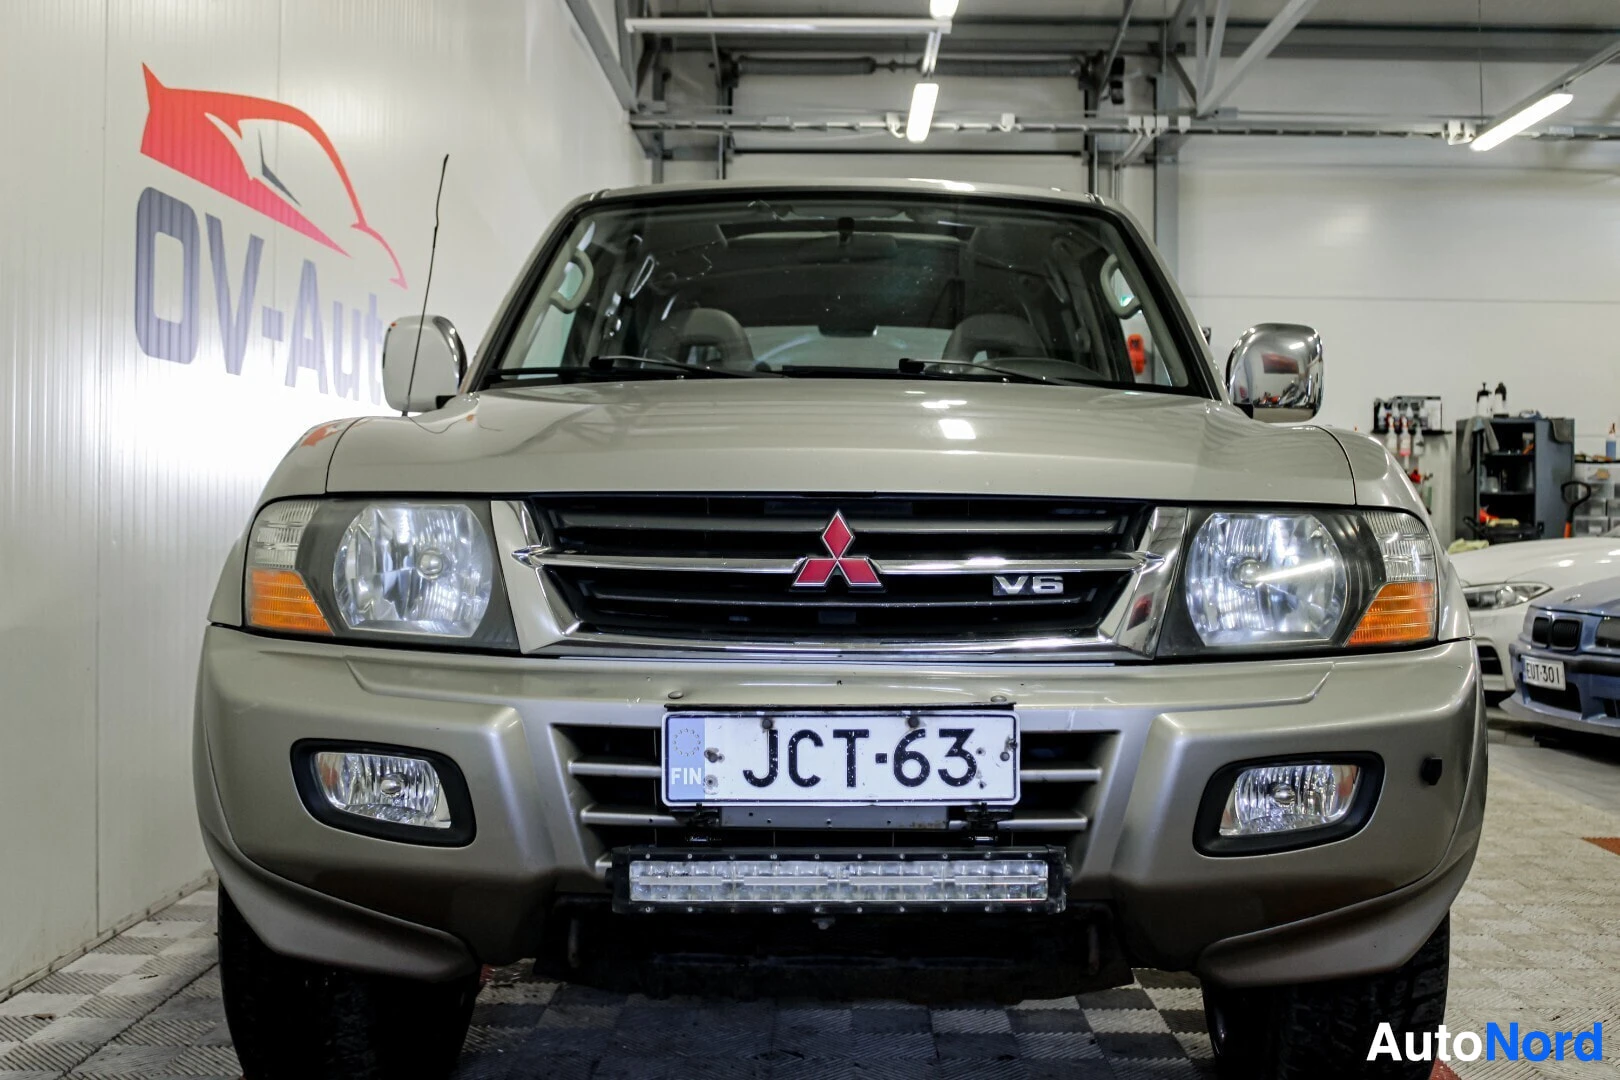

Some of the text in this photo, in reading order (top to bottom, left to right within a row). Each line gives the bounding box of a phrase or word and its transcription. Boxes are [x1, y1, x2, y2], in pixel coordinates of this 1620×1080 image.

[135, 186, 383, 406] OV-Aut
[994, 575, 1064, 595] V6
[1526, 662, 1560, 684] EUT-301
[742, 728, 978, 788] JCT-63
[670, 767, 702, 786] FIN
